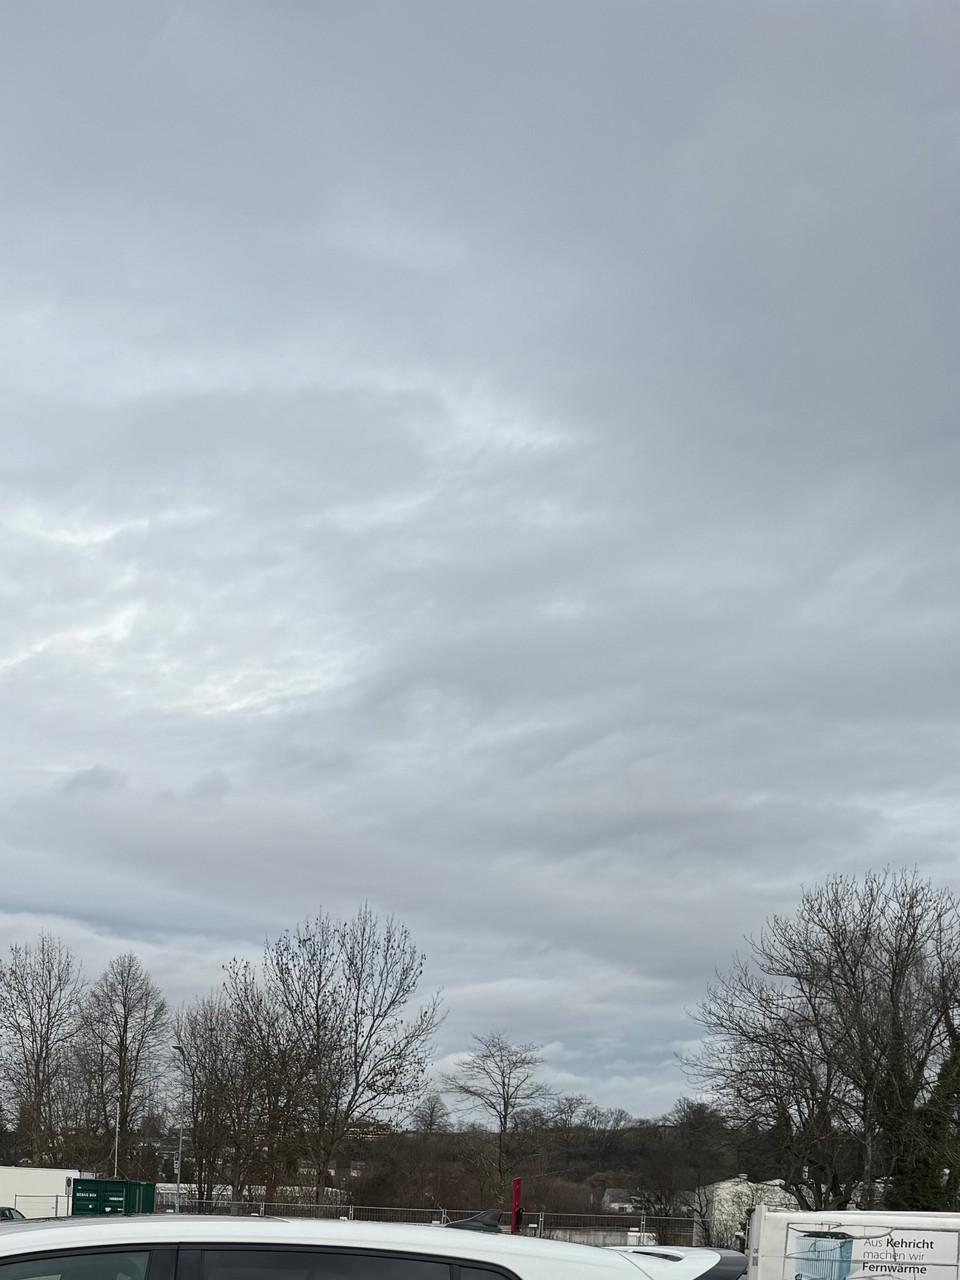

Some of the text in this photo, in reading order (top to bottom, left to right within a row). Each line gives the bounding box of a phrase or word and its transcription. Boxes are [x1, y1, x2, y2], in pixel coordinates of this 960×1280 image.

[863, 1238, 935, 1249] Aus Kehricht
[863, 1250, 926, 1261] machen wir
[862, 1262, 927, 1274] Fernwärme
